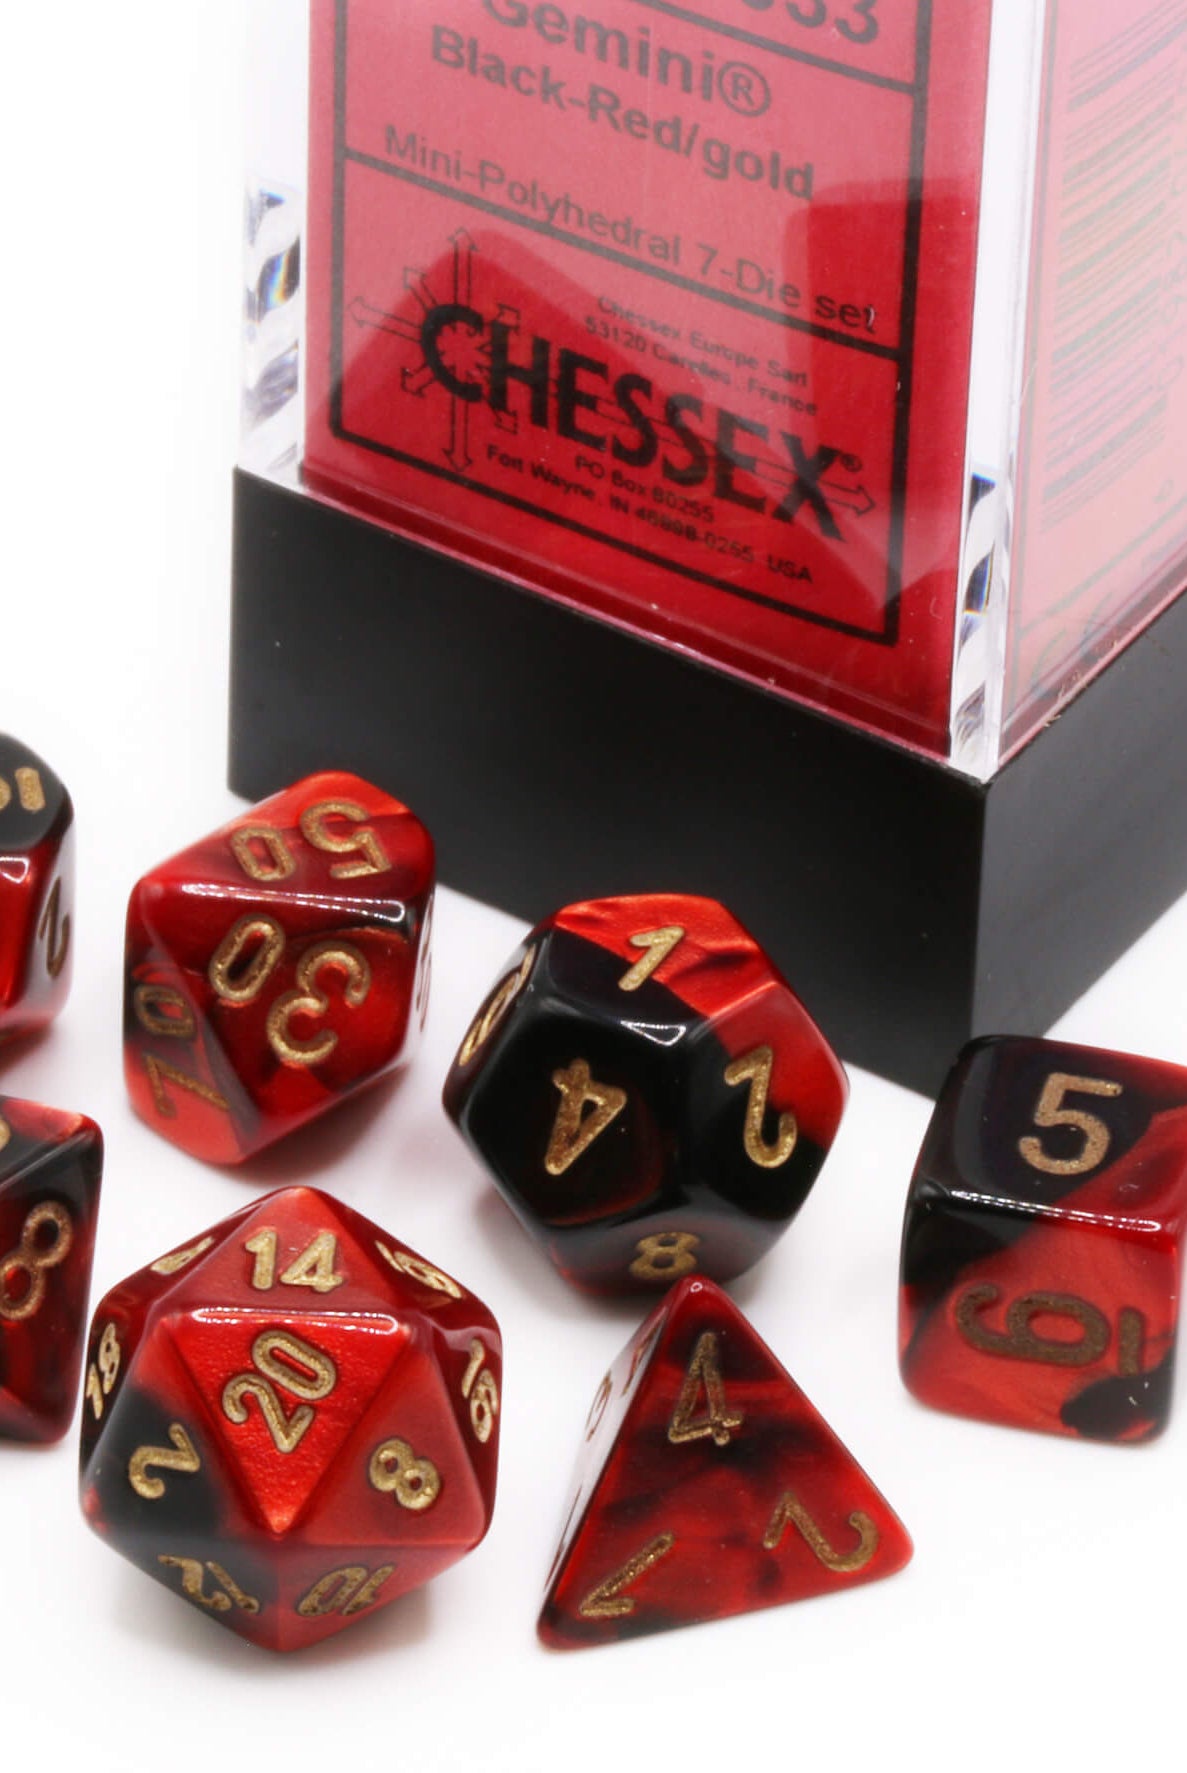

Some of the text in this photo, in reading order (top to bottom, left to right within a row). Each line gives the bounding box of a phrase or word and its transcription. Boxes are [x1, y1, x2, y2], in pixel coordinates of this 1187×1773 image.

[432, 25, 814, 201] Black-Red/gold
[384, 124, 877, 334] Mini-Polyhedral 7-Die set
[585, 316, 647, 352] 53120
[747, 378, 817, 417] France
[598, 296, 679, 337] Chessex
[690, 331, 758, 370] Europe
[486, 443, 523, 473] Fort
[768, 554, 813, 583] USA
[575, 454, 605, 478] PO
[611, 469, 646, 495] Box
[231, 802, 391, 881] 50
[208, 914, 372, 1068] 30
[618, 925, 686, 992] 1
[543, 1058, 628, 1176] 4
[723, 1044, 798, 1169] 2
[1017, 1071, 1124, 1176] 5
[0, 1200, 73, 1322] 8
[244, 1229, 345, 1293] 14
[628, 1230, 700, 1281] 8
[221, 1329, 338, 1454] 20
[667, 1331, 745, 1447] 4
[128, 1422, 200, 1499] 2
[369, 1438, 441, 1511] 8
[762, 1491, 880, 1574] 2
